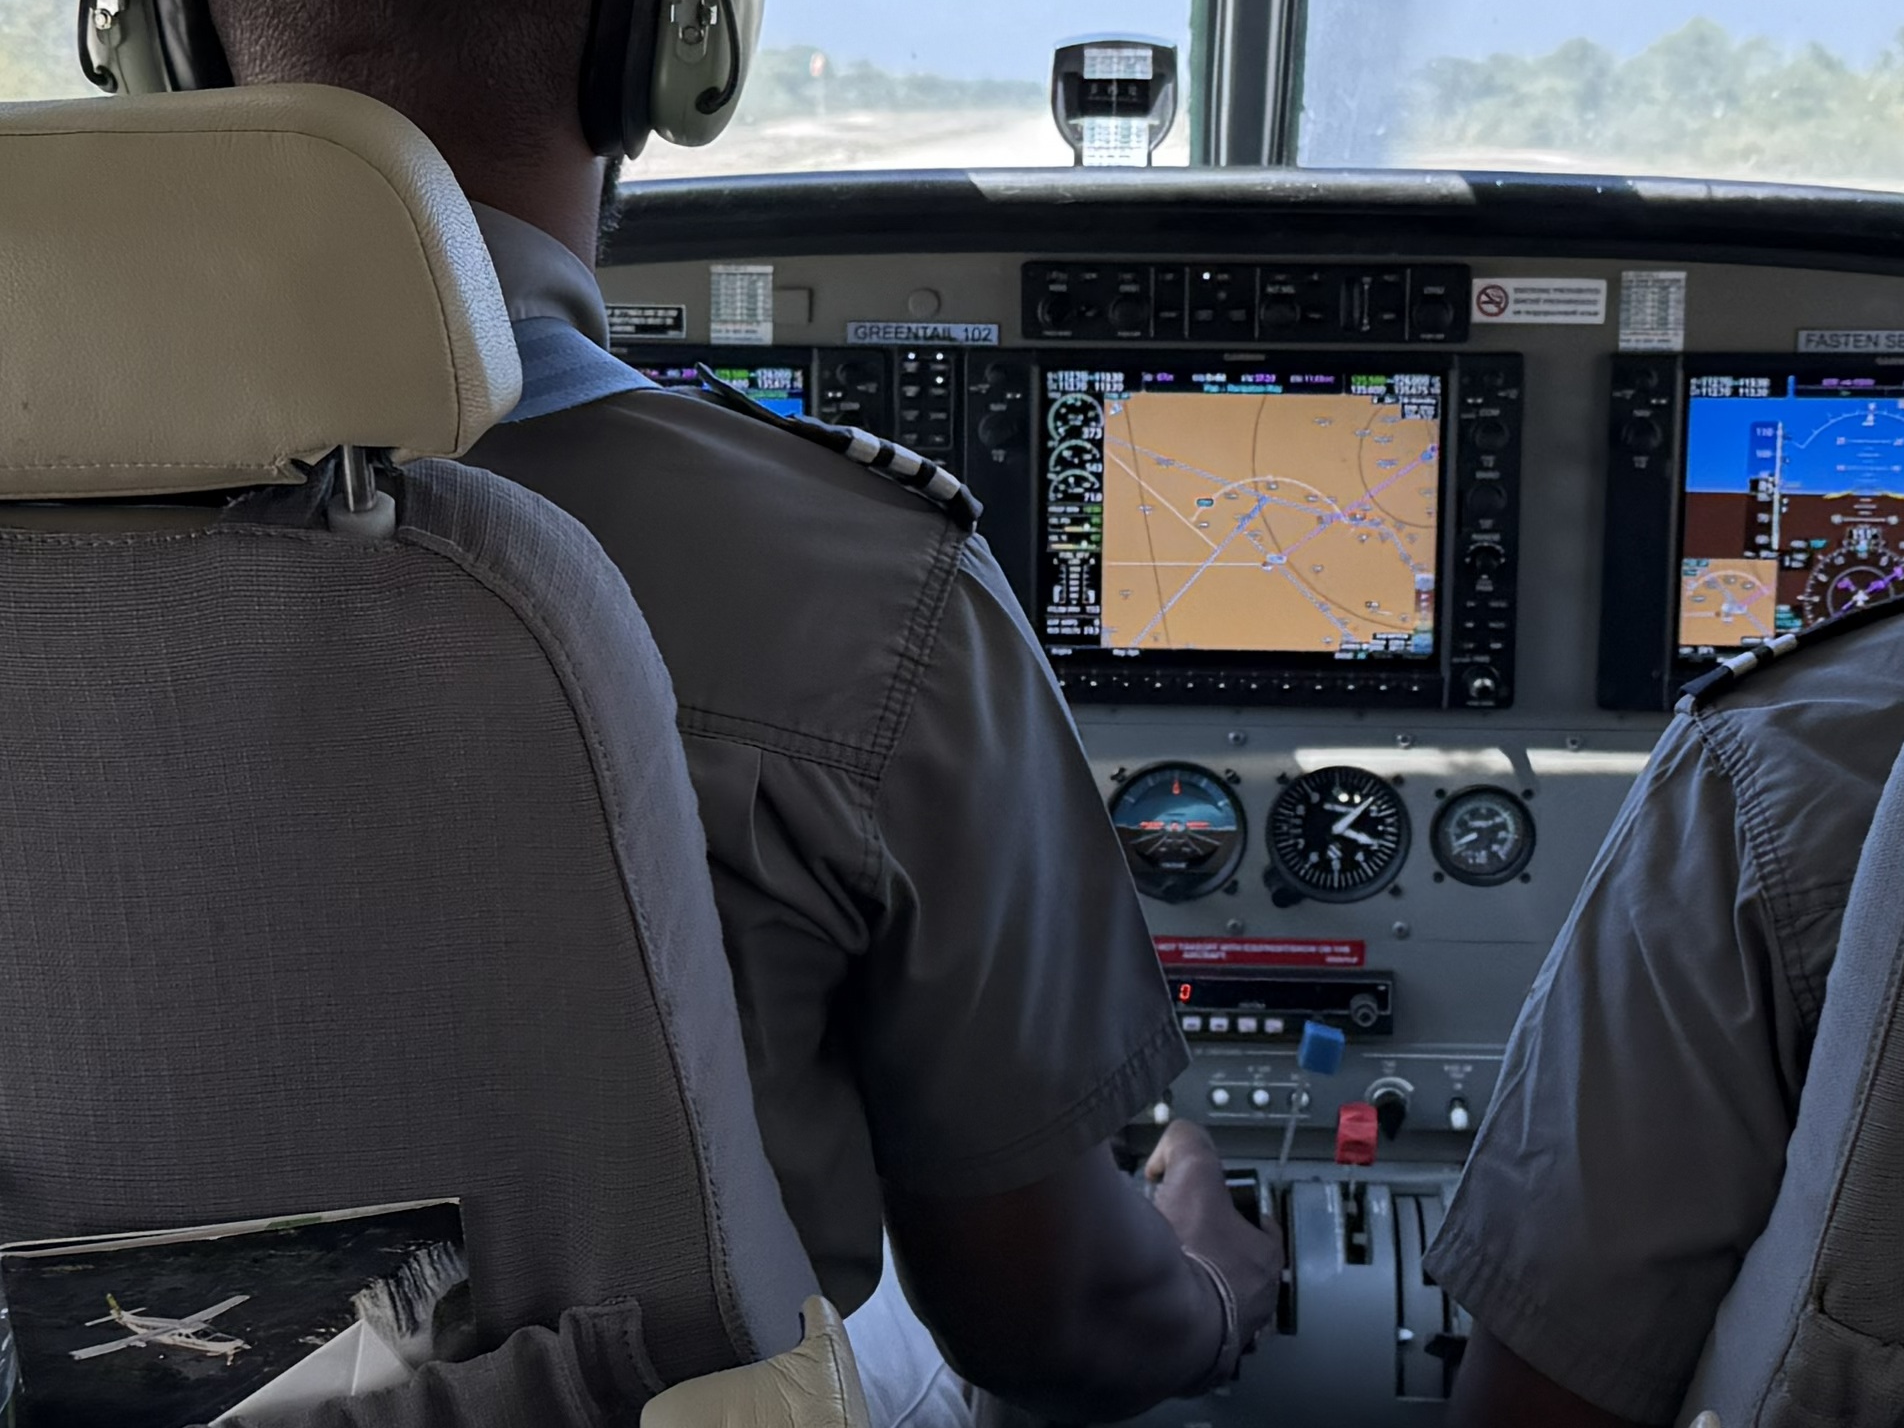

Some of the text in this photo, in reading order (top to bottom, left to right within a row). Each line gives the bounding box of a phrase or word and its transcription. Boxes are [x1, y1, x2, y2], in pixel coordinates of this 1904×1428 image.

[853, 324, 994, 343] GREENTAIL 102
[1804, 333, 1879, 349] FASTEN
